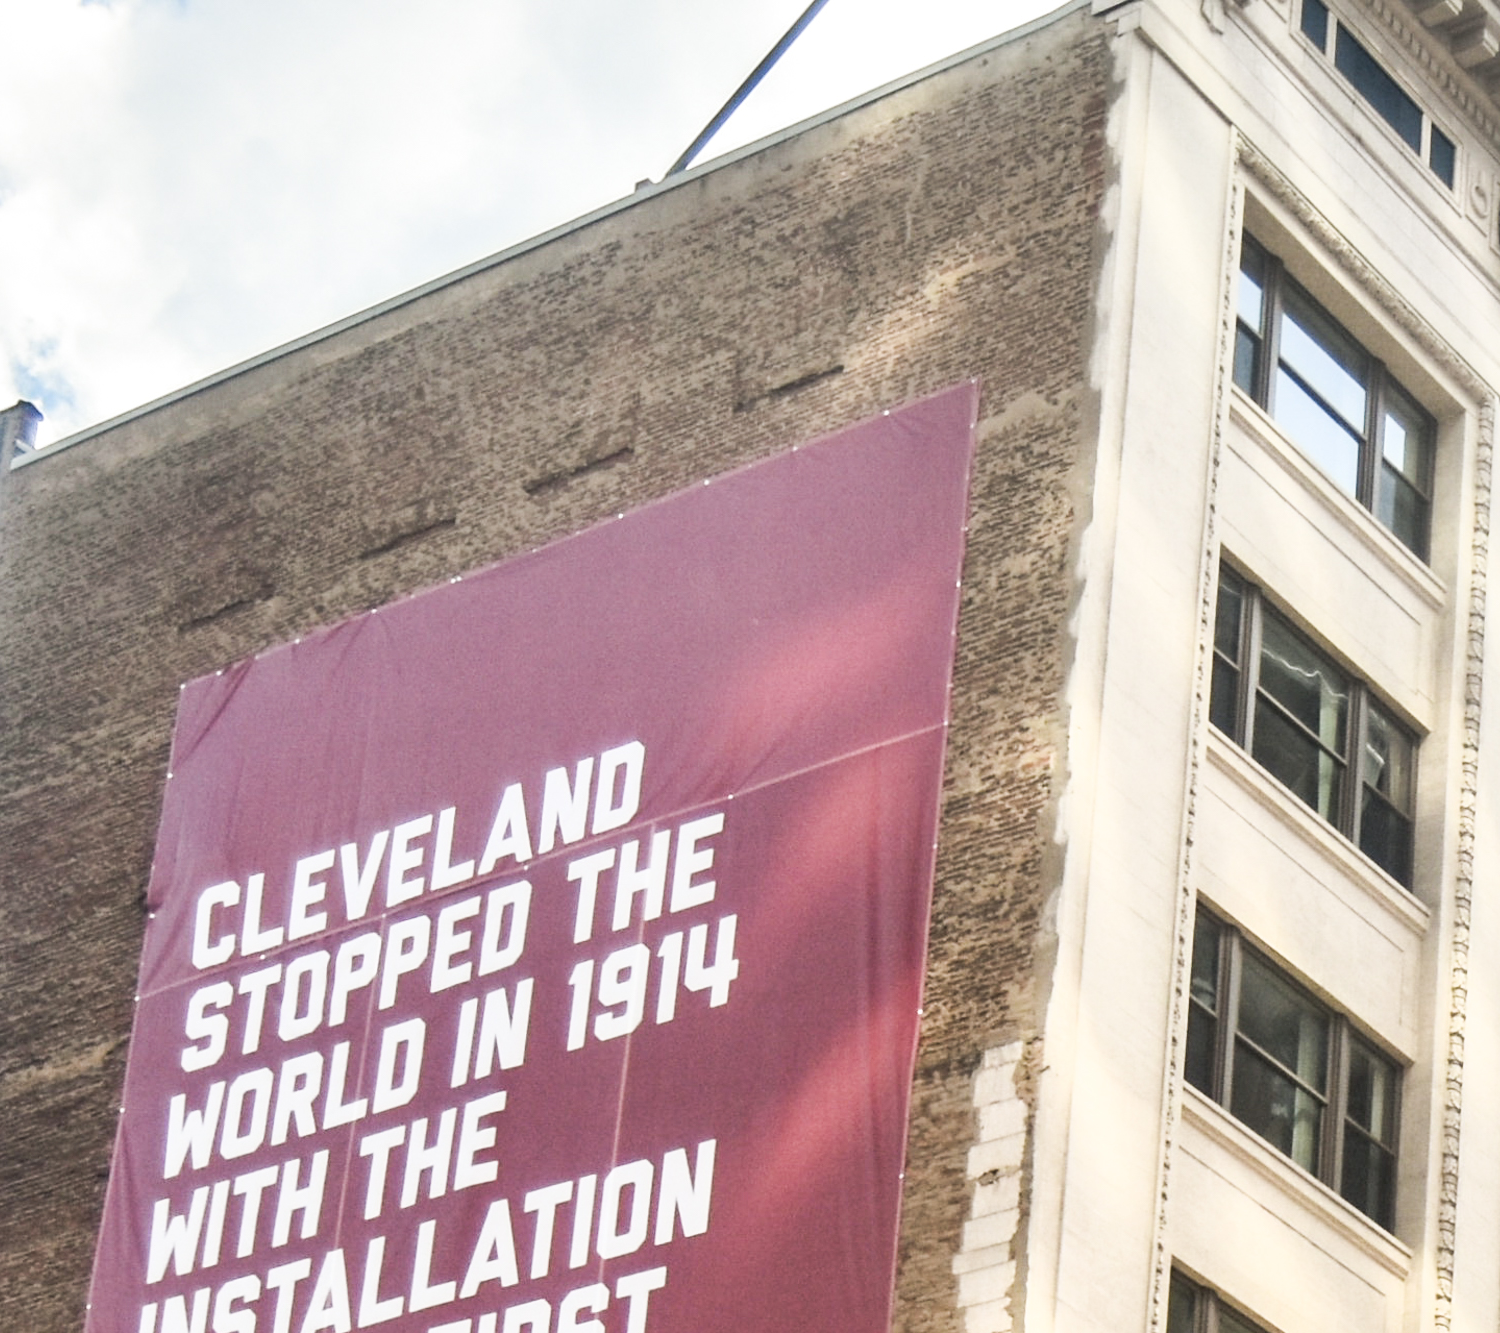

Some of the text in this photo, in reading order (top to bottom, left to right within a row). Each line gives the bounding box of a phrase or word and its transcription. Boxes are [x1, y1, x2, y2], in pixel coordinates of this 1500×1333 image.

[178, 810, 727, 1075] STOPPED THE
[189, 738, 648, 972] CLEVELAND
[161, 912, 741, 1182] WORLD IN 1914
[144, 1088, 509, 1287] WITH THE
